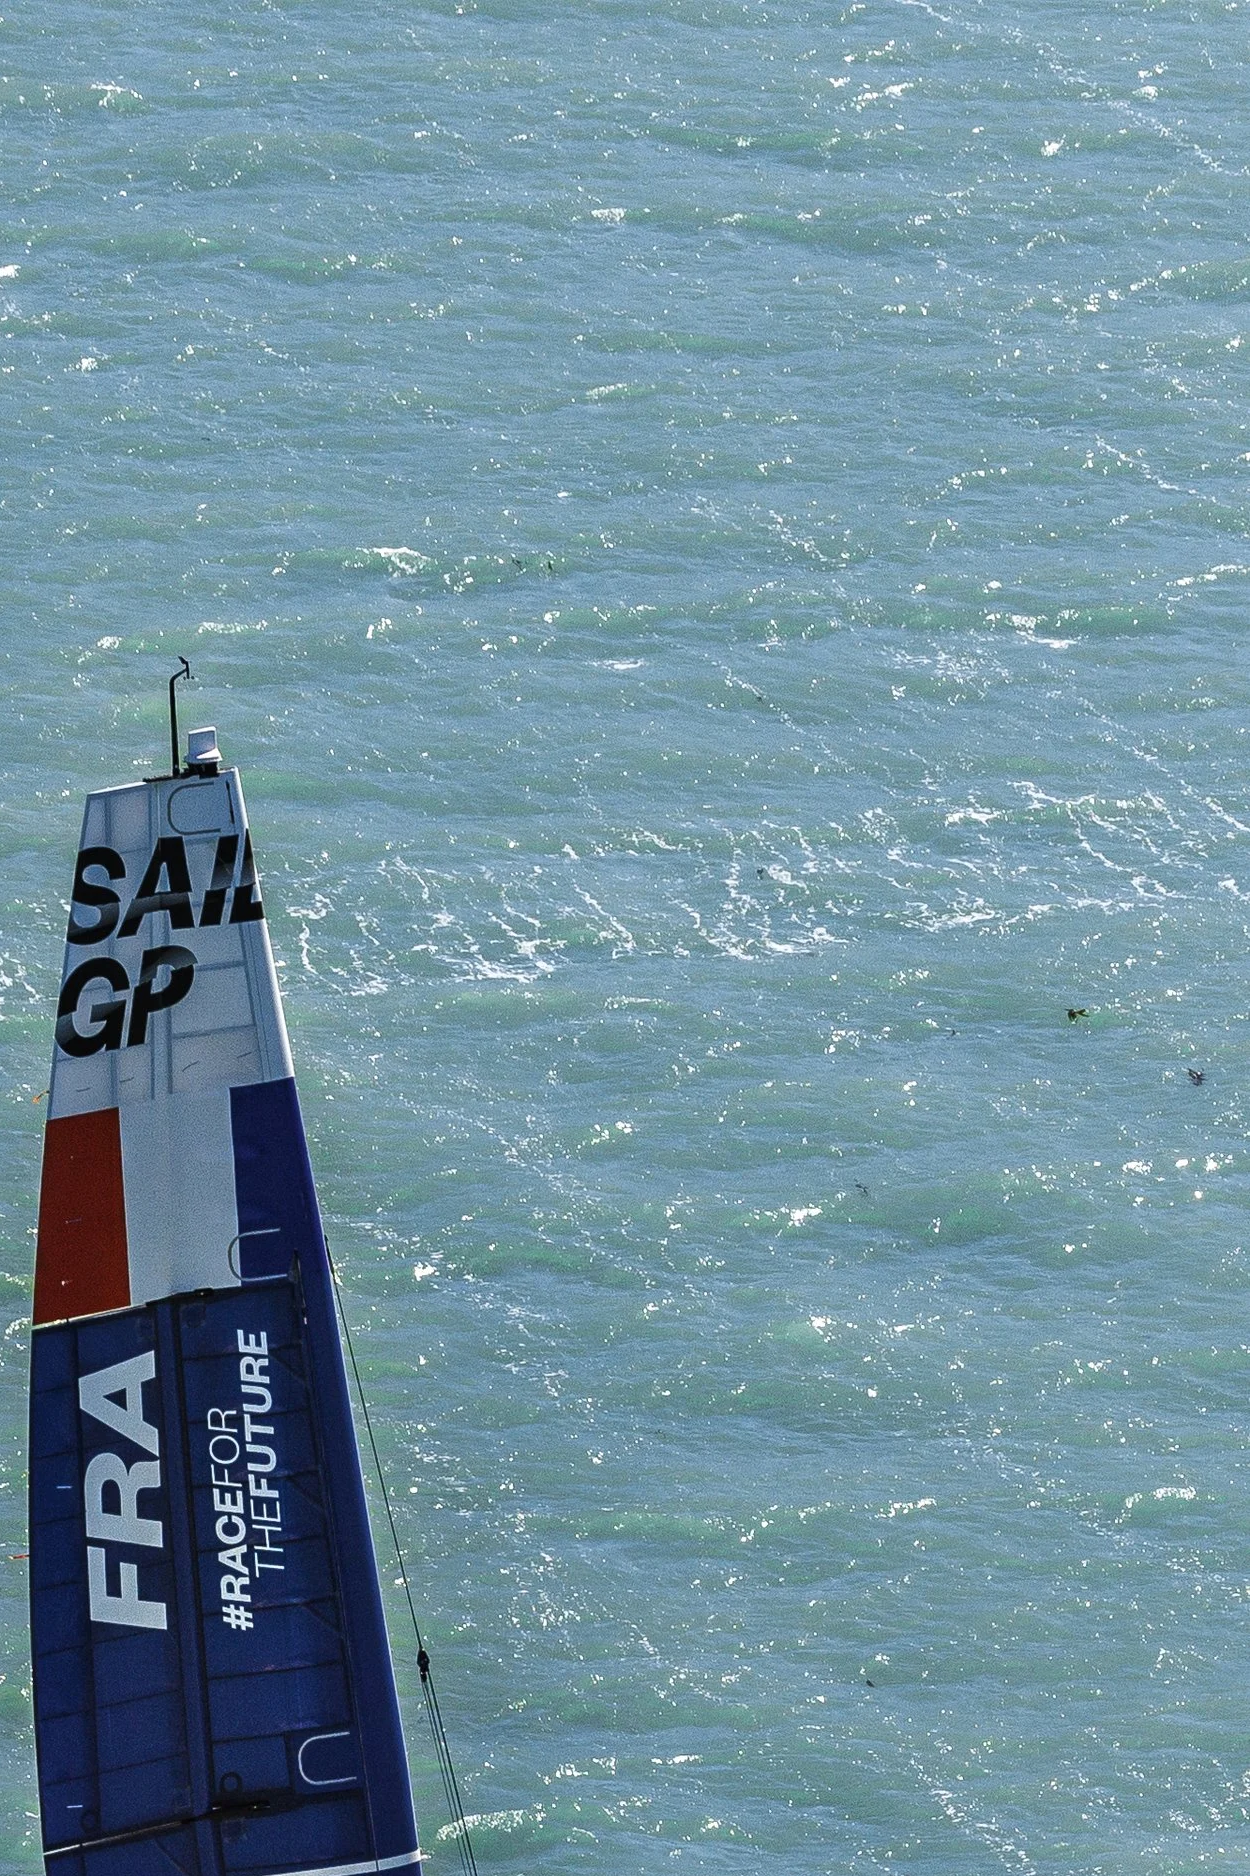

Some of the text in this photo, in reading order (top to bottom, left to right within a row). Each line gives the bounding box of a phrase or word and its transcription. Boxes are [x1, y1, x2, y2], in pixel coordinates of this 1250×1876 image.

[66, 828, 266, 946] SAIL
[54, 944, 199, 1058] GP
[78, 1350, 168, 1631] FRA
[206, 1406, 254, 1632] #RACEFOR
[236, 1328, 285, 1580] THEFUTURE
